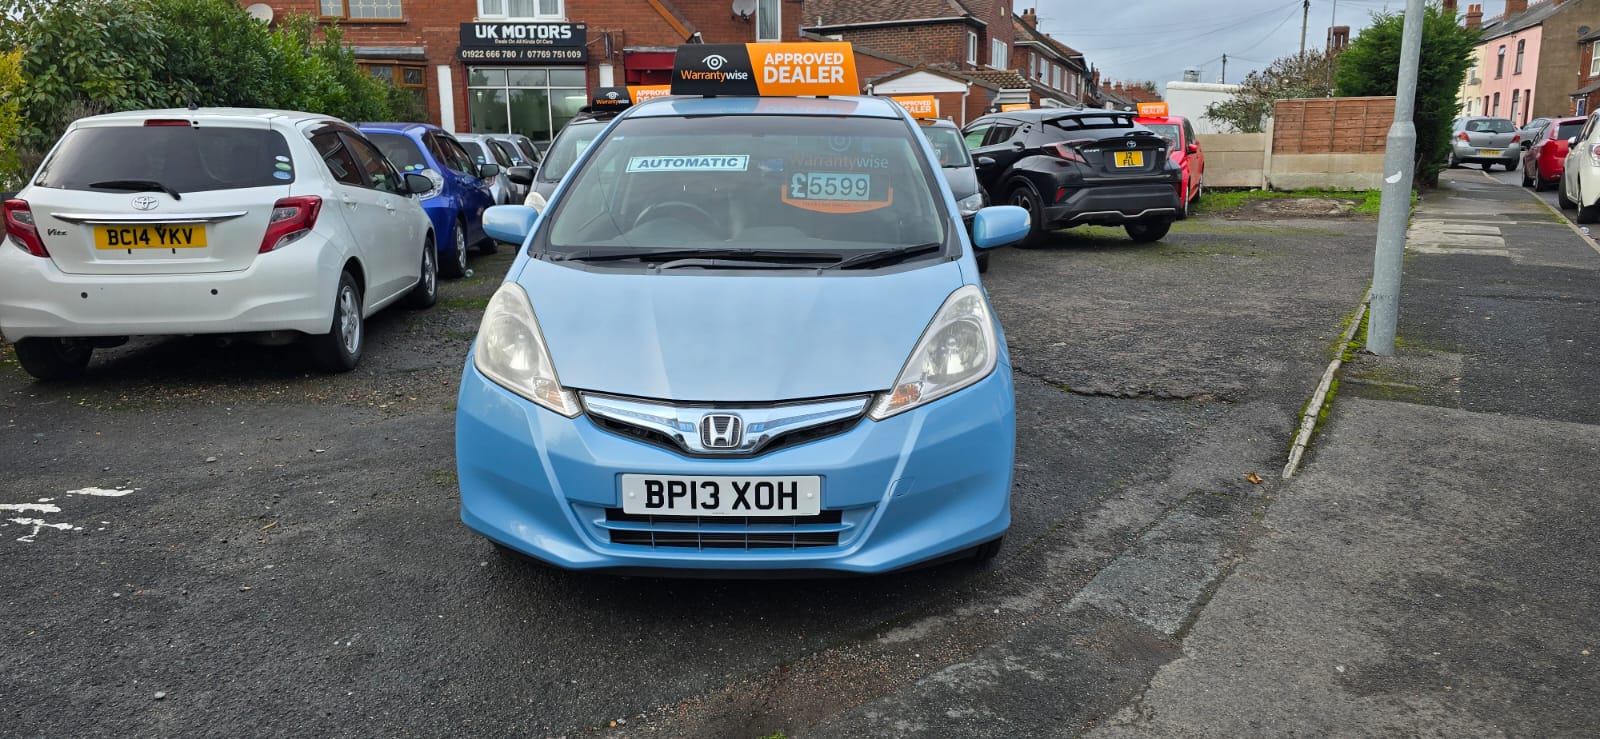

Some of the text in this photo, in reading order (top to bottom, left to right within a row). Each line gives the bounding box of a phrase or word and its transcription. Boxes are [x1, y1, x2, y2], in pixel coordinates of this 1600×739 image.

[475, 25, 572, 38] UK MOTORS
[764, 53, 844, 64] APPROVED
[680, 69, 748, 82] Warrantywise
[764, 66, 844, 84] DEALER
[638, 157, 738, 169] AUTOMATIC
[791, 173, 868, 198] £5599
[106, 228, 192, 245] BC14 YKV
[645, 480, 798, 510] BP13 XOH
